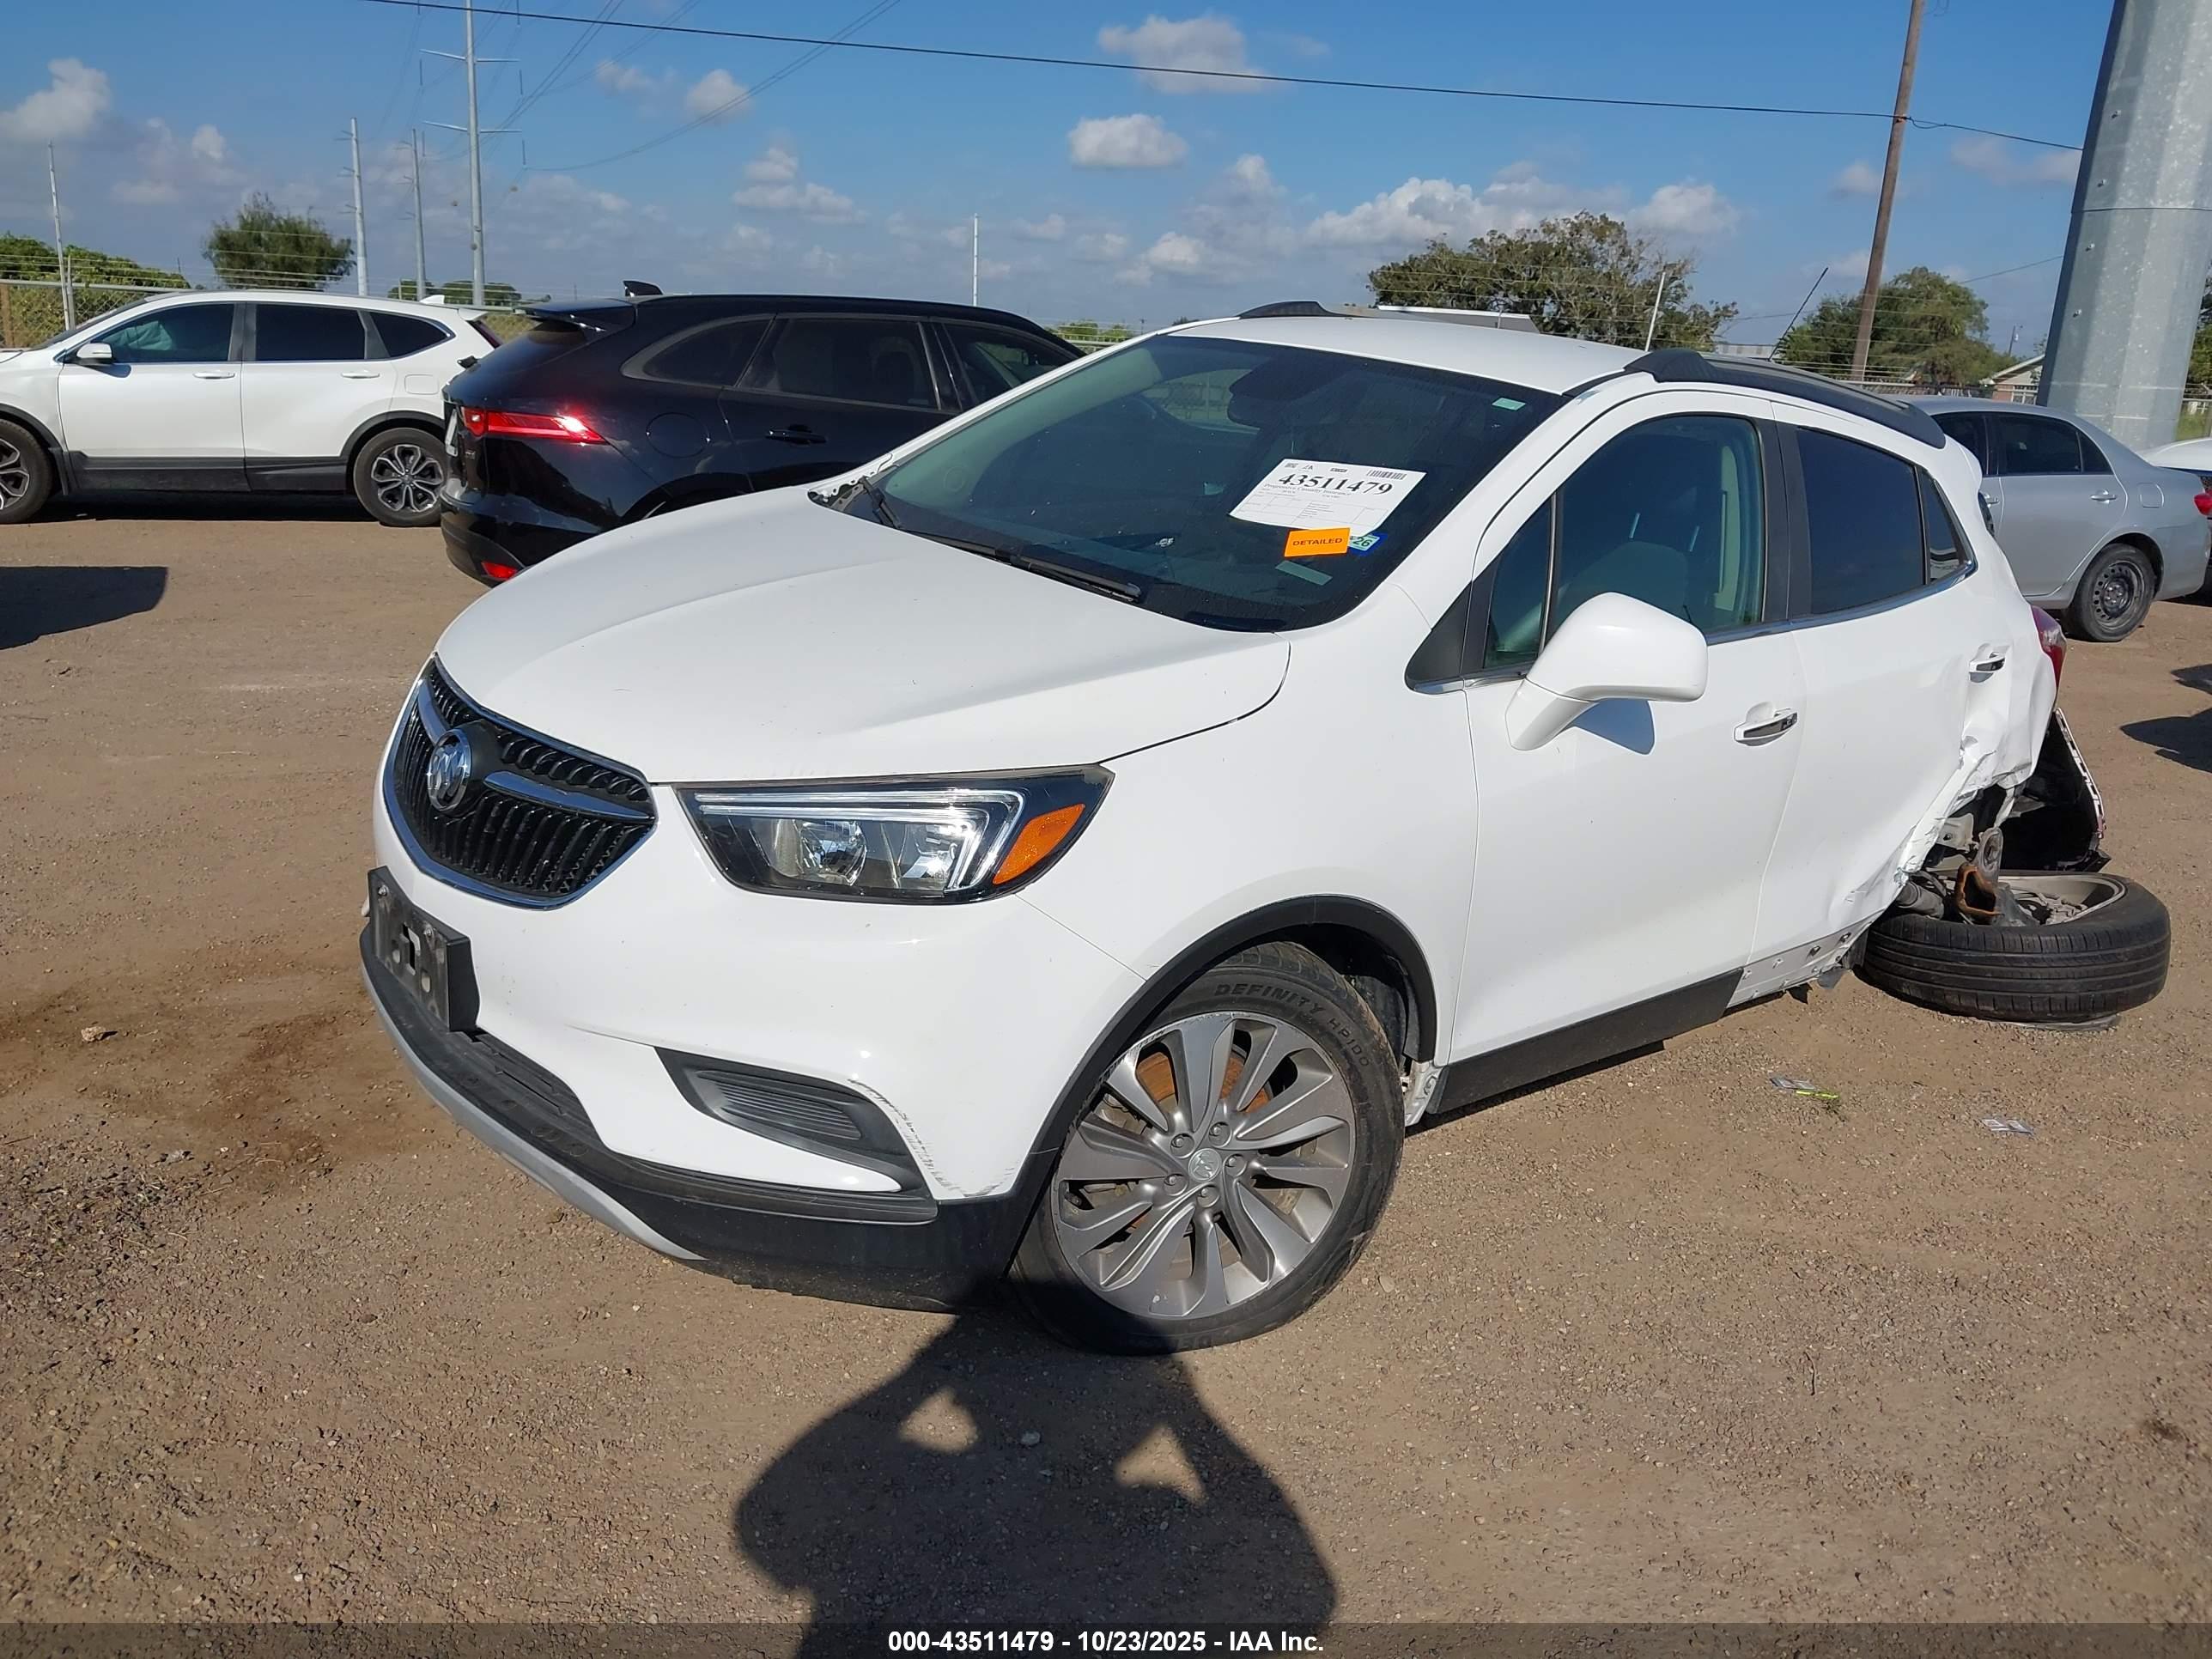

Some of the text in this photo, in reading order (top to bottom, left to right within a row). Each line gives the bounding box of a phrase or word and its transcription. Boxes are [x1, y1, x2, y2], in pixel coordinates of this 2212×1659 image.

[1279, 473, 1393, 495] 43511479
[1292, 538, 1343, 546] DETAILED
[1352, 537, 1373, 547] 26
[1214, 983, 1326, 1014] DEFINITY
